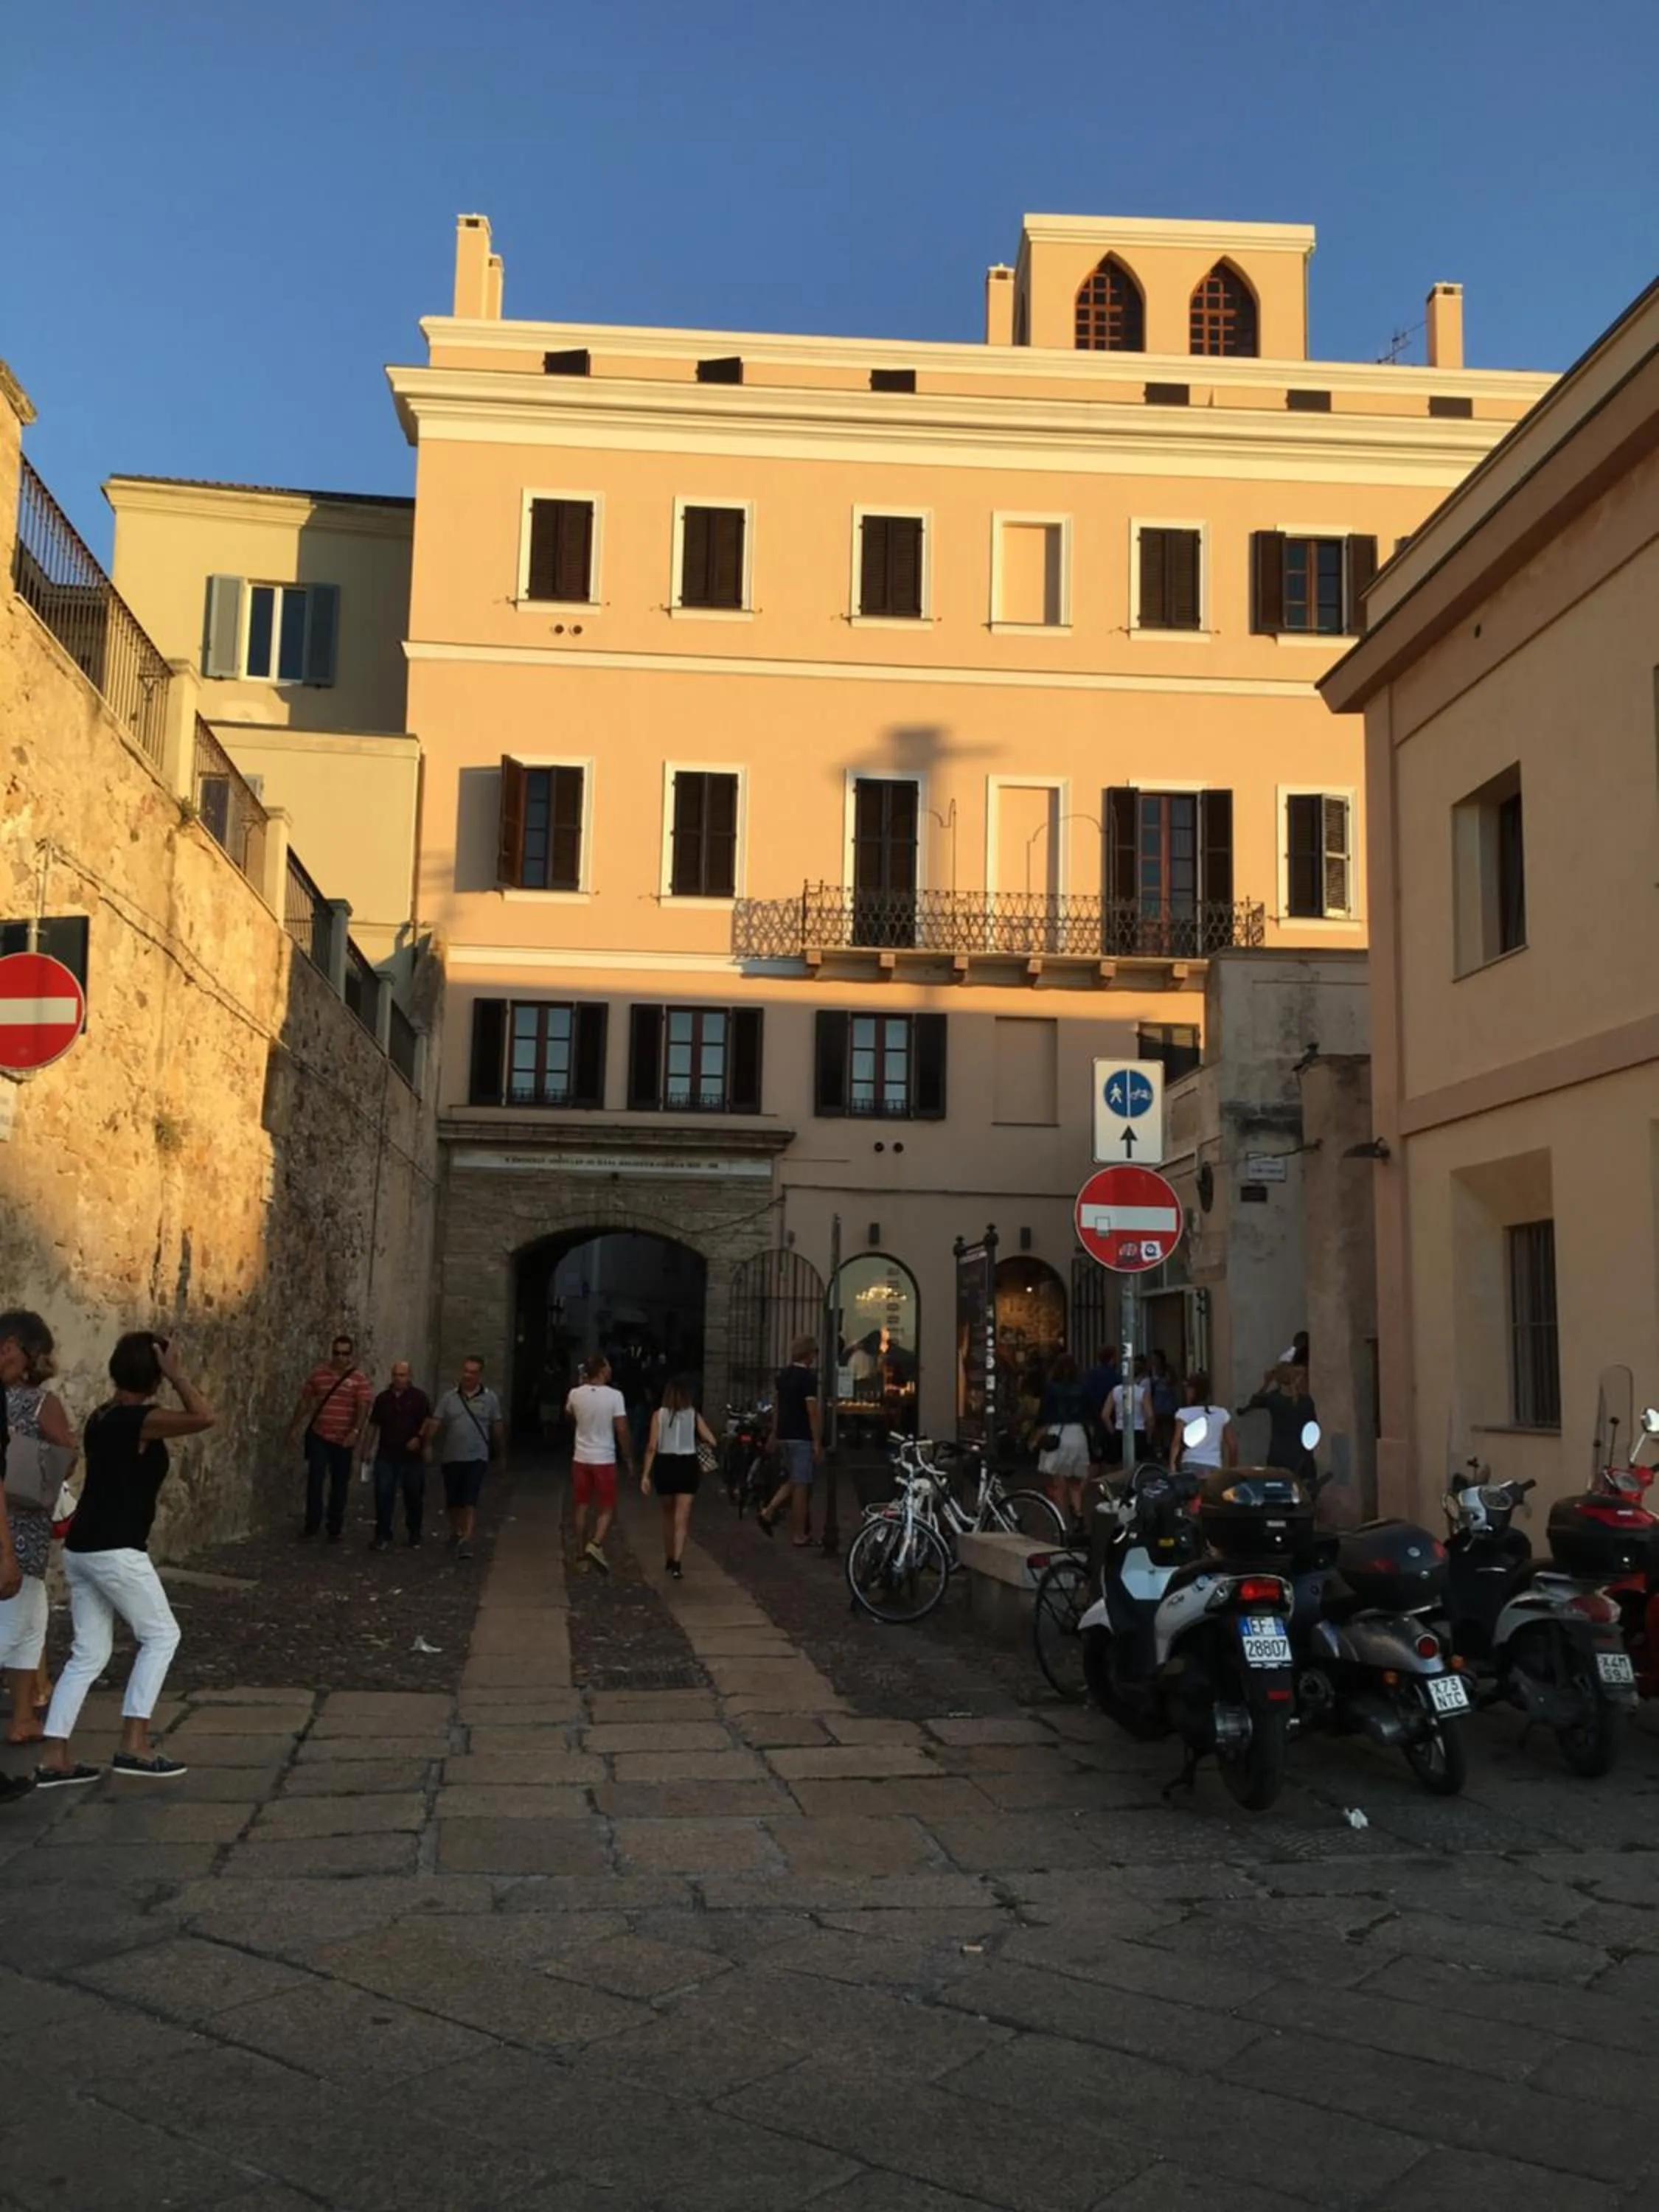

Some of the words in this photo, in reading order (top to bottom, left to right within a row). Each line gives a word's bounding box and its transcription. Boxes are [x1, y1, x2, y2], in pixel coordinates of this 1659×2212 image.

[1251, 1616, 1267, 1635] EF
[1246, 1639, 1287, 1658] 28807
[1436, 1691, 1464, 1708] NTC
